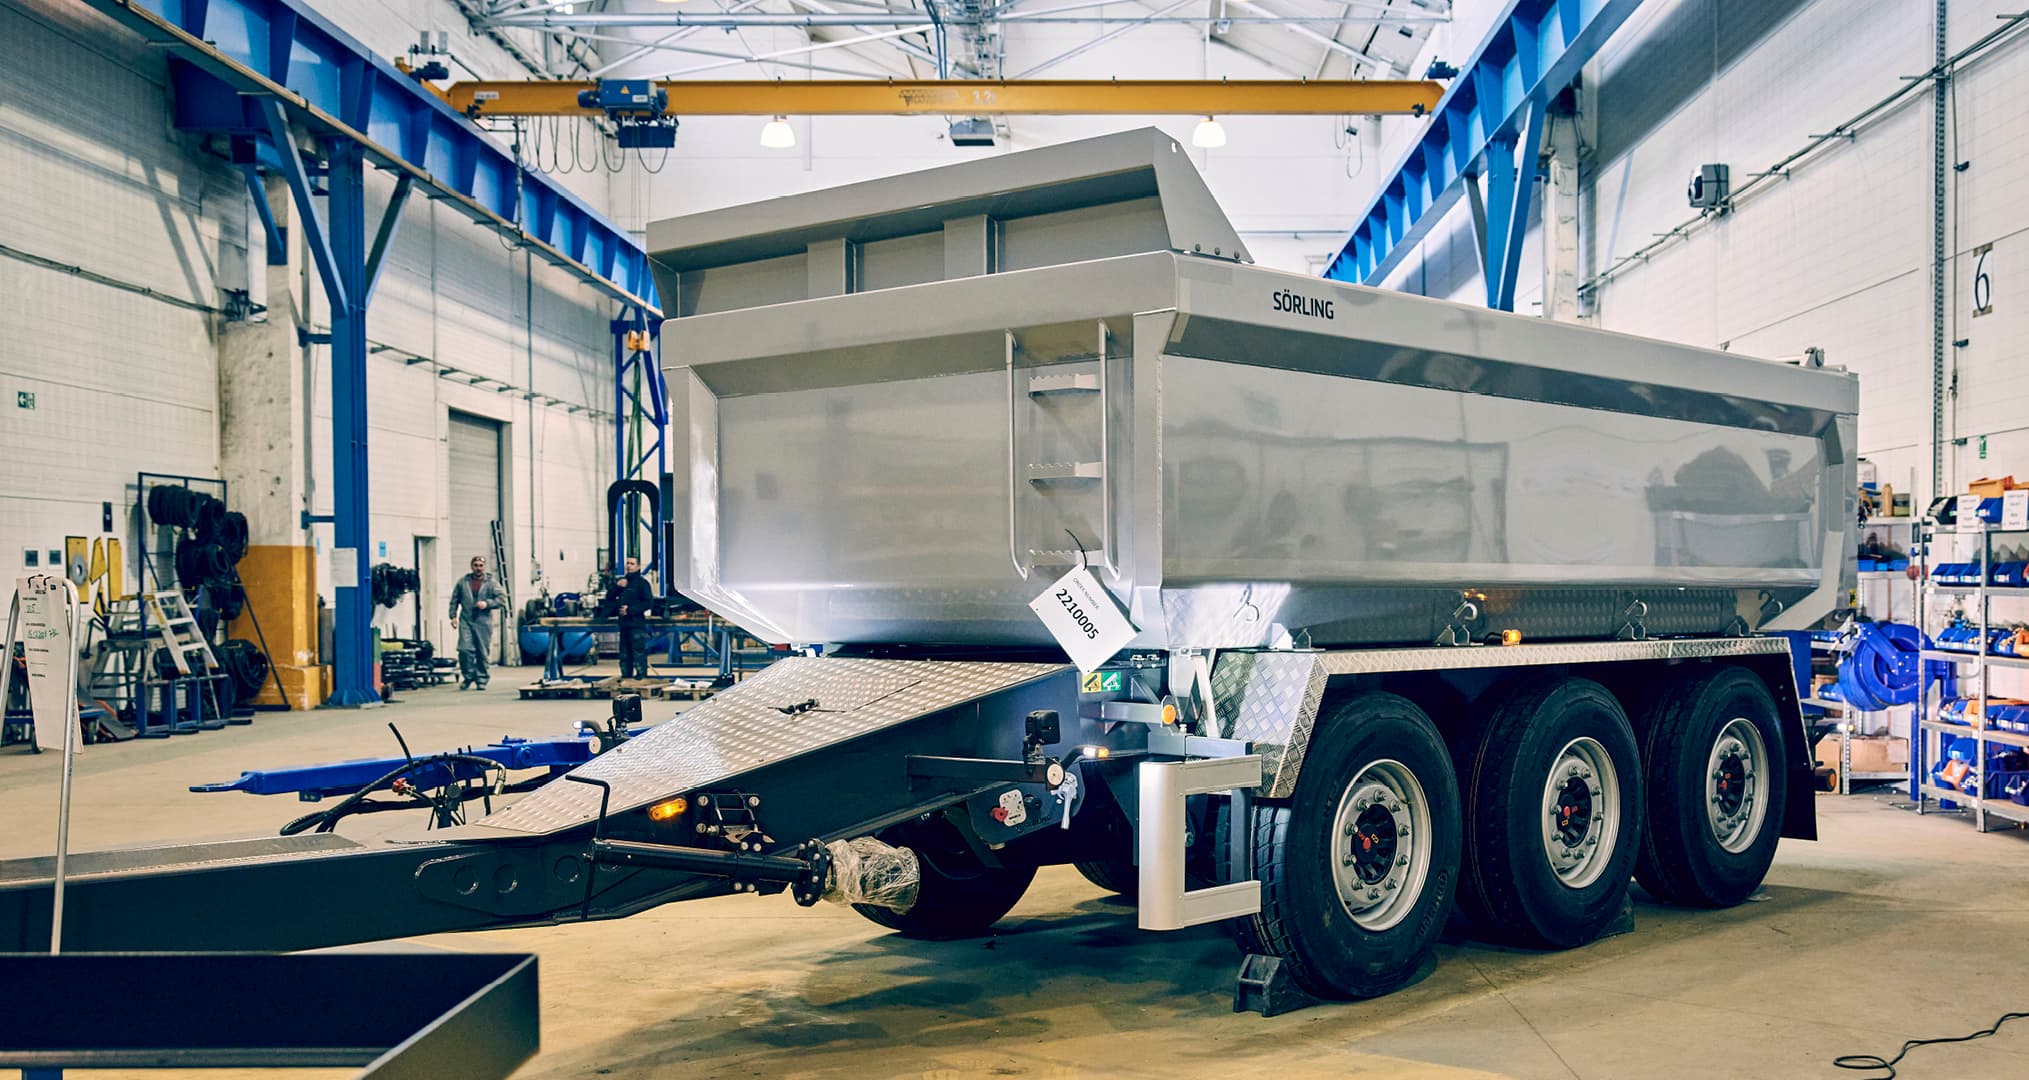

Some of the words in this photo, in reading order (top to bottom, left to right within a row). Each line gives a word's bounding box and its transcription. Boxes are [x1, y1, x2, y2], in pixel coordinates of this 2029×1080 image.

[1273, 289, 1334, 319] SÖRLING
[1975, 248, 1992, 312] 6
[1056, 588, 1099, 639] 2210005
